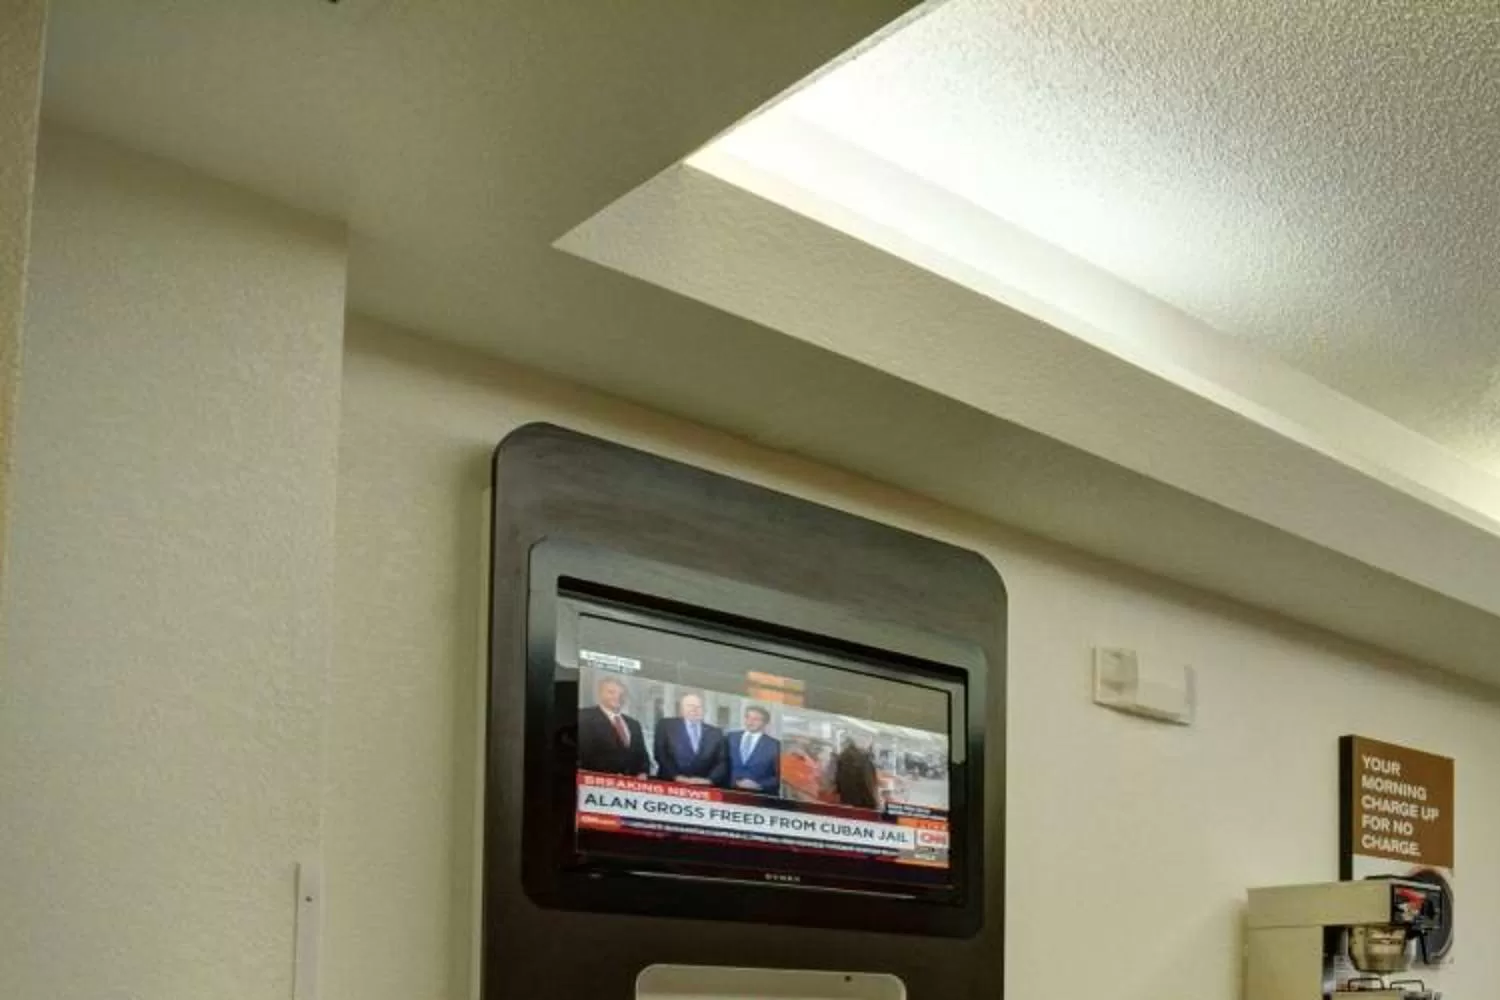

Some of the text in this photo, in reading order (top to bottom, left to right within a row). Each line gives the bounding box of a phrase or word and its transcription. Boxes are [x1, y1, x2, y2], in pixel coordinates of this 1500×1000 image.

[1361, 755, 1401, 777] YOUR
[583, 775, 711, 801] BREAKING NEWS
[1361, 774, 1427, 801] MORNING
[584, 793, 638, 812] ALAN
[643, 802, 706, 819] GROSS
[709, 807, 765, 826] FREED
[769, 816, 817, 833] FROM
[820, 821, 875, 840] CUBAN
[877, 829, 909, 843] JAIL
[1360, 795, 1440, 821] CHARGE UP
[1361, 814, 1414, 837] FOR NO
[1360, 834, 1422, 857] CHARGE.
